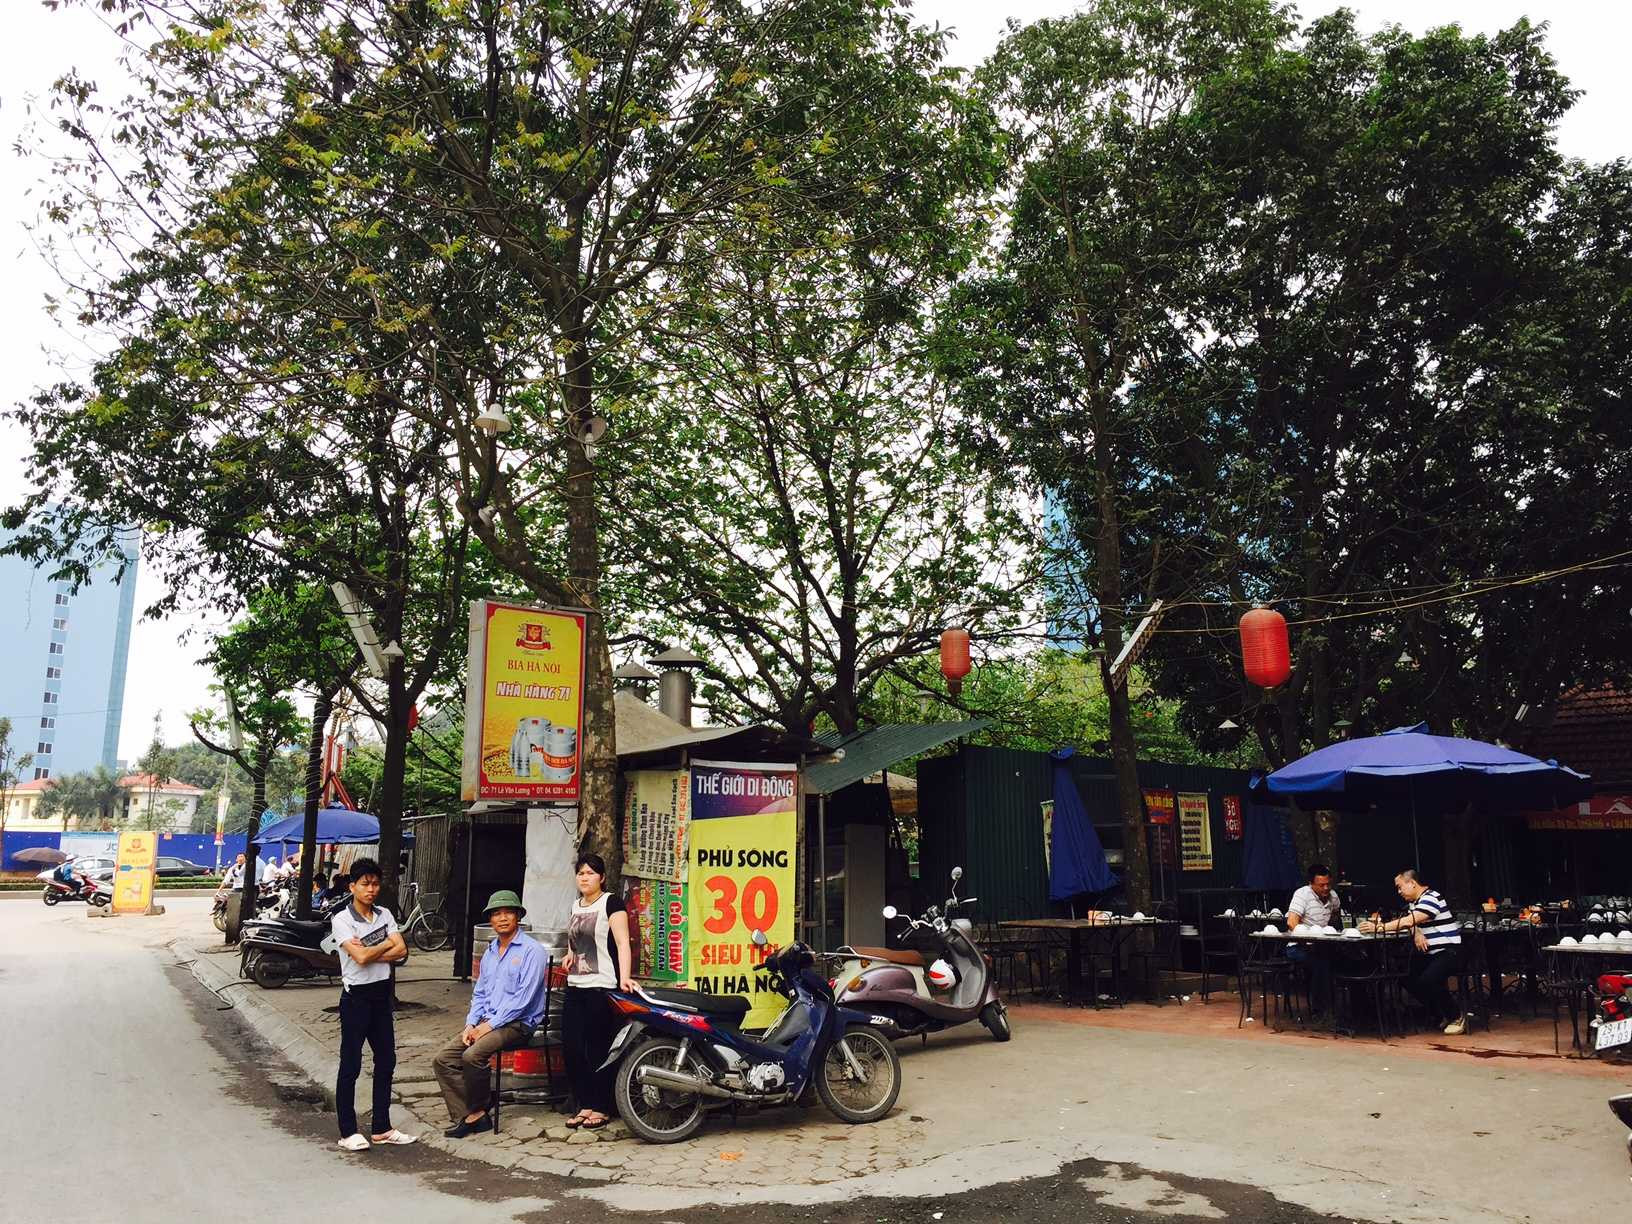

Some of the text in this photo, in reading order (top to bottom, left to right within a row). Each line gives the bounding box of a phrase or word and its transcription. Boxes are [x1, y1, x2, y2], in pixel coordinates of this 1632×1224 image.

[508, 660, 524, 670] BIA
[558, 686, 571, 701] 71
[696, 772, 721, 794] THẾ
[722, 775, 744, 796] GIỚI
[748, 778, 760, 796] DI
[761, 776, 794, 800] ĐỘNG
[698, 845, 733, 867] PHỦ
[703, 874, 779, 934] 30
[668, 930, 683, 973] QUAY
[747, 944, 779, 965] TH
